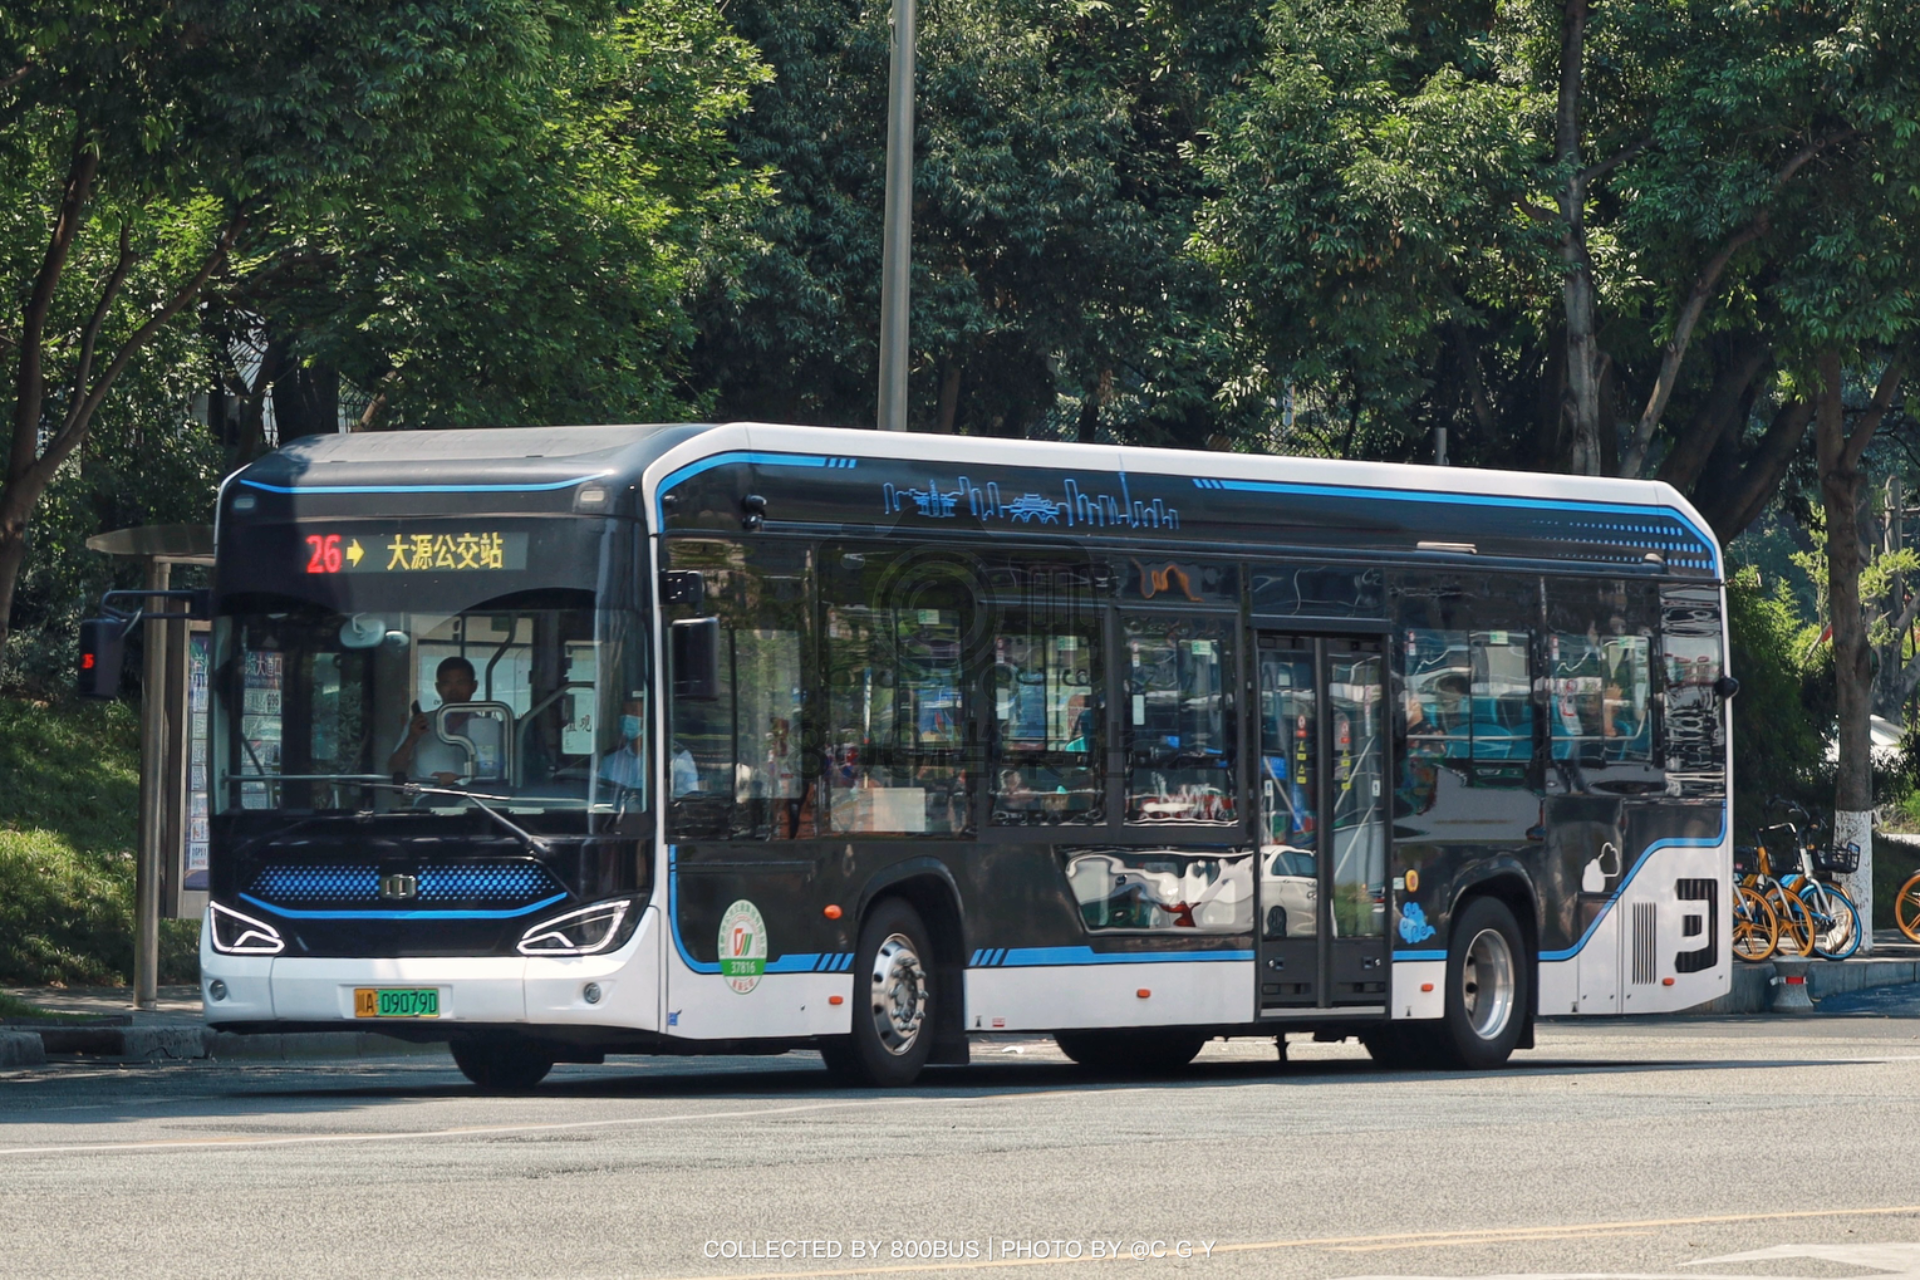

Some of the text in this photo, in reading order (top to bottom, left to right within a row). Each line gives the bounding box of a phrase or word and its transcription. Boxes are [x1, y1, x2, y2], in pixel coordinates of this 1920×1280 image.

[305, 534, 342, 574] 26
[386, 531, 504, 571] 大源公交站
[731, 961, 756, 974] 37816
